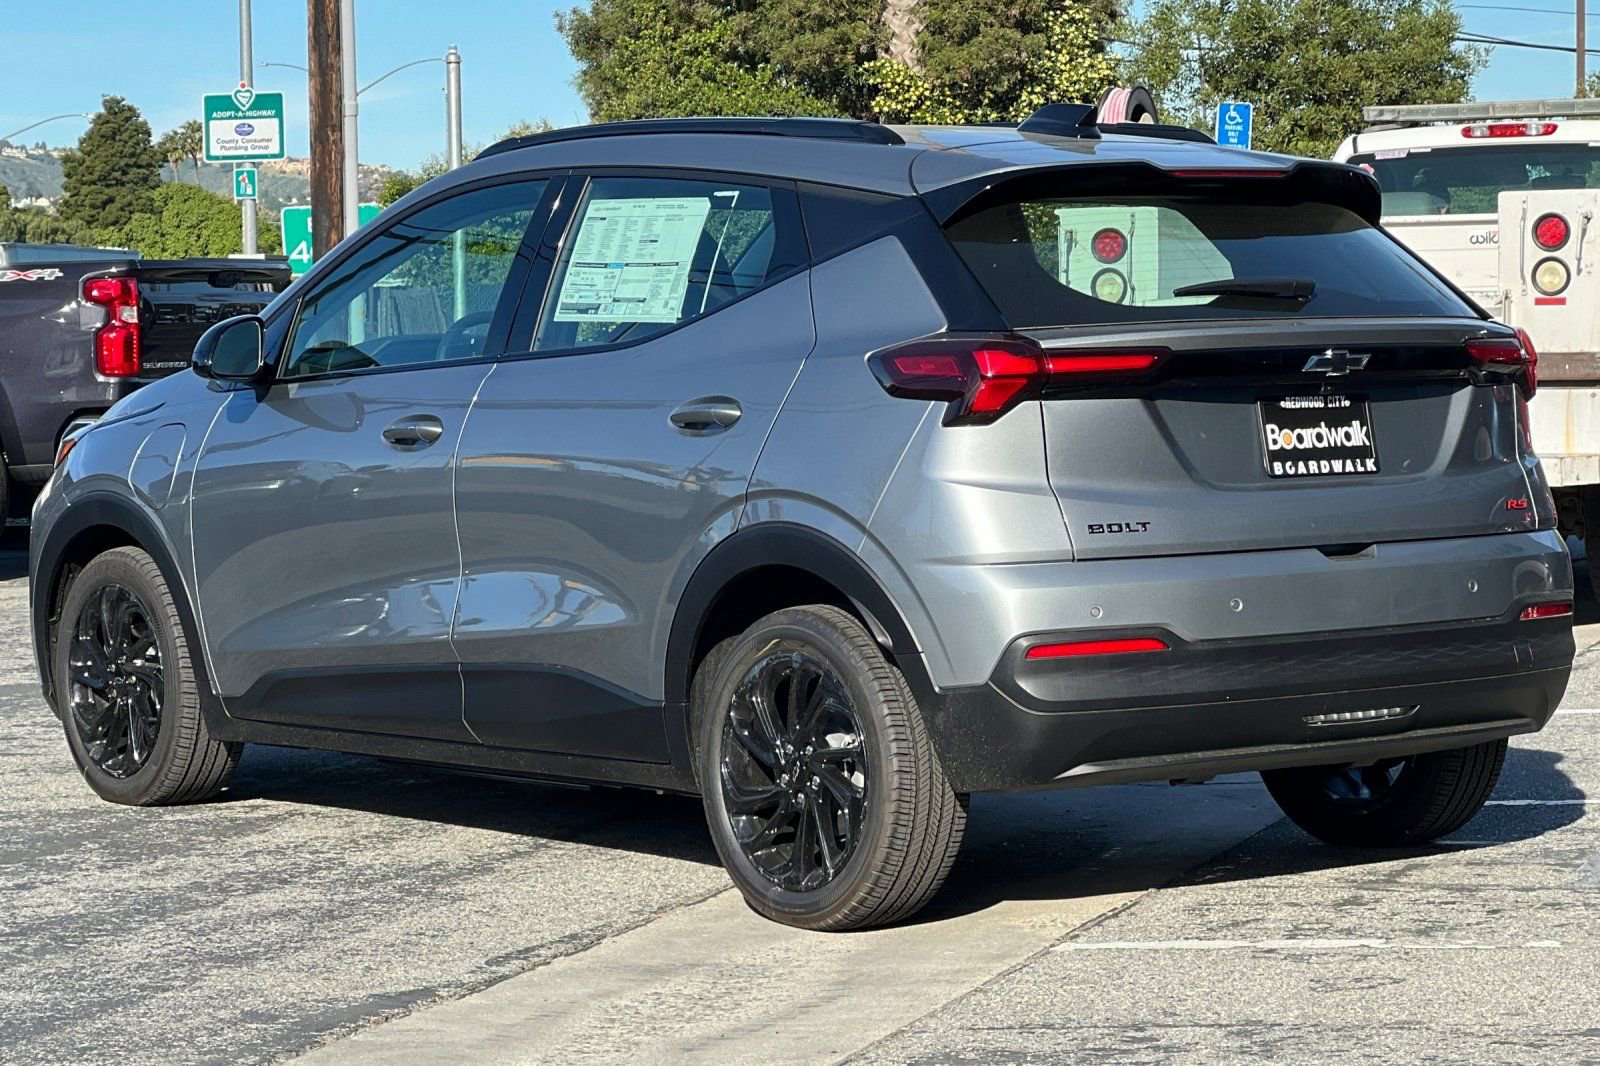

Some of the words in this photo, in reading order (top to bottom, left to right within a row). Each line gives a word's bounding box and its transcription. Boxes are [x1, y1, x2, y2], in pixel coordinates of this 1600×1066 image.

[212, 109, 276, 118] ADOPT-A-HIGHWAY
[143, 361, 188, 369] SILVERADO
[1285, 396, 1325, 408] REDWOOD
[1327, 395, 1346, 408] CITY
[1265, 420, 1371, 450] Boardwalk
[1272, 458, 1377, 475] BOARDWALK
[1505, 498, 1528, 510] RS
[1087, 522, 1150, 534] BOLT
